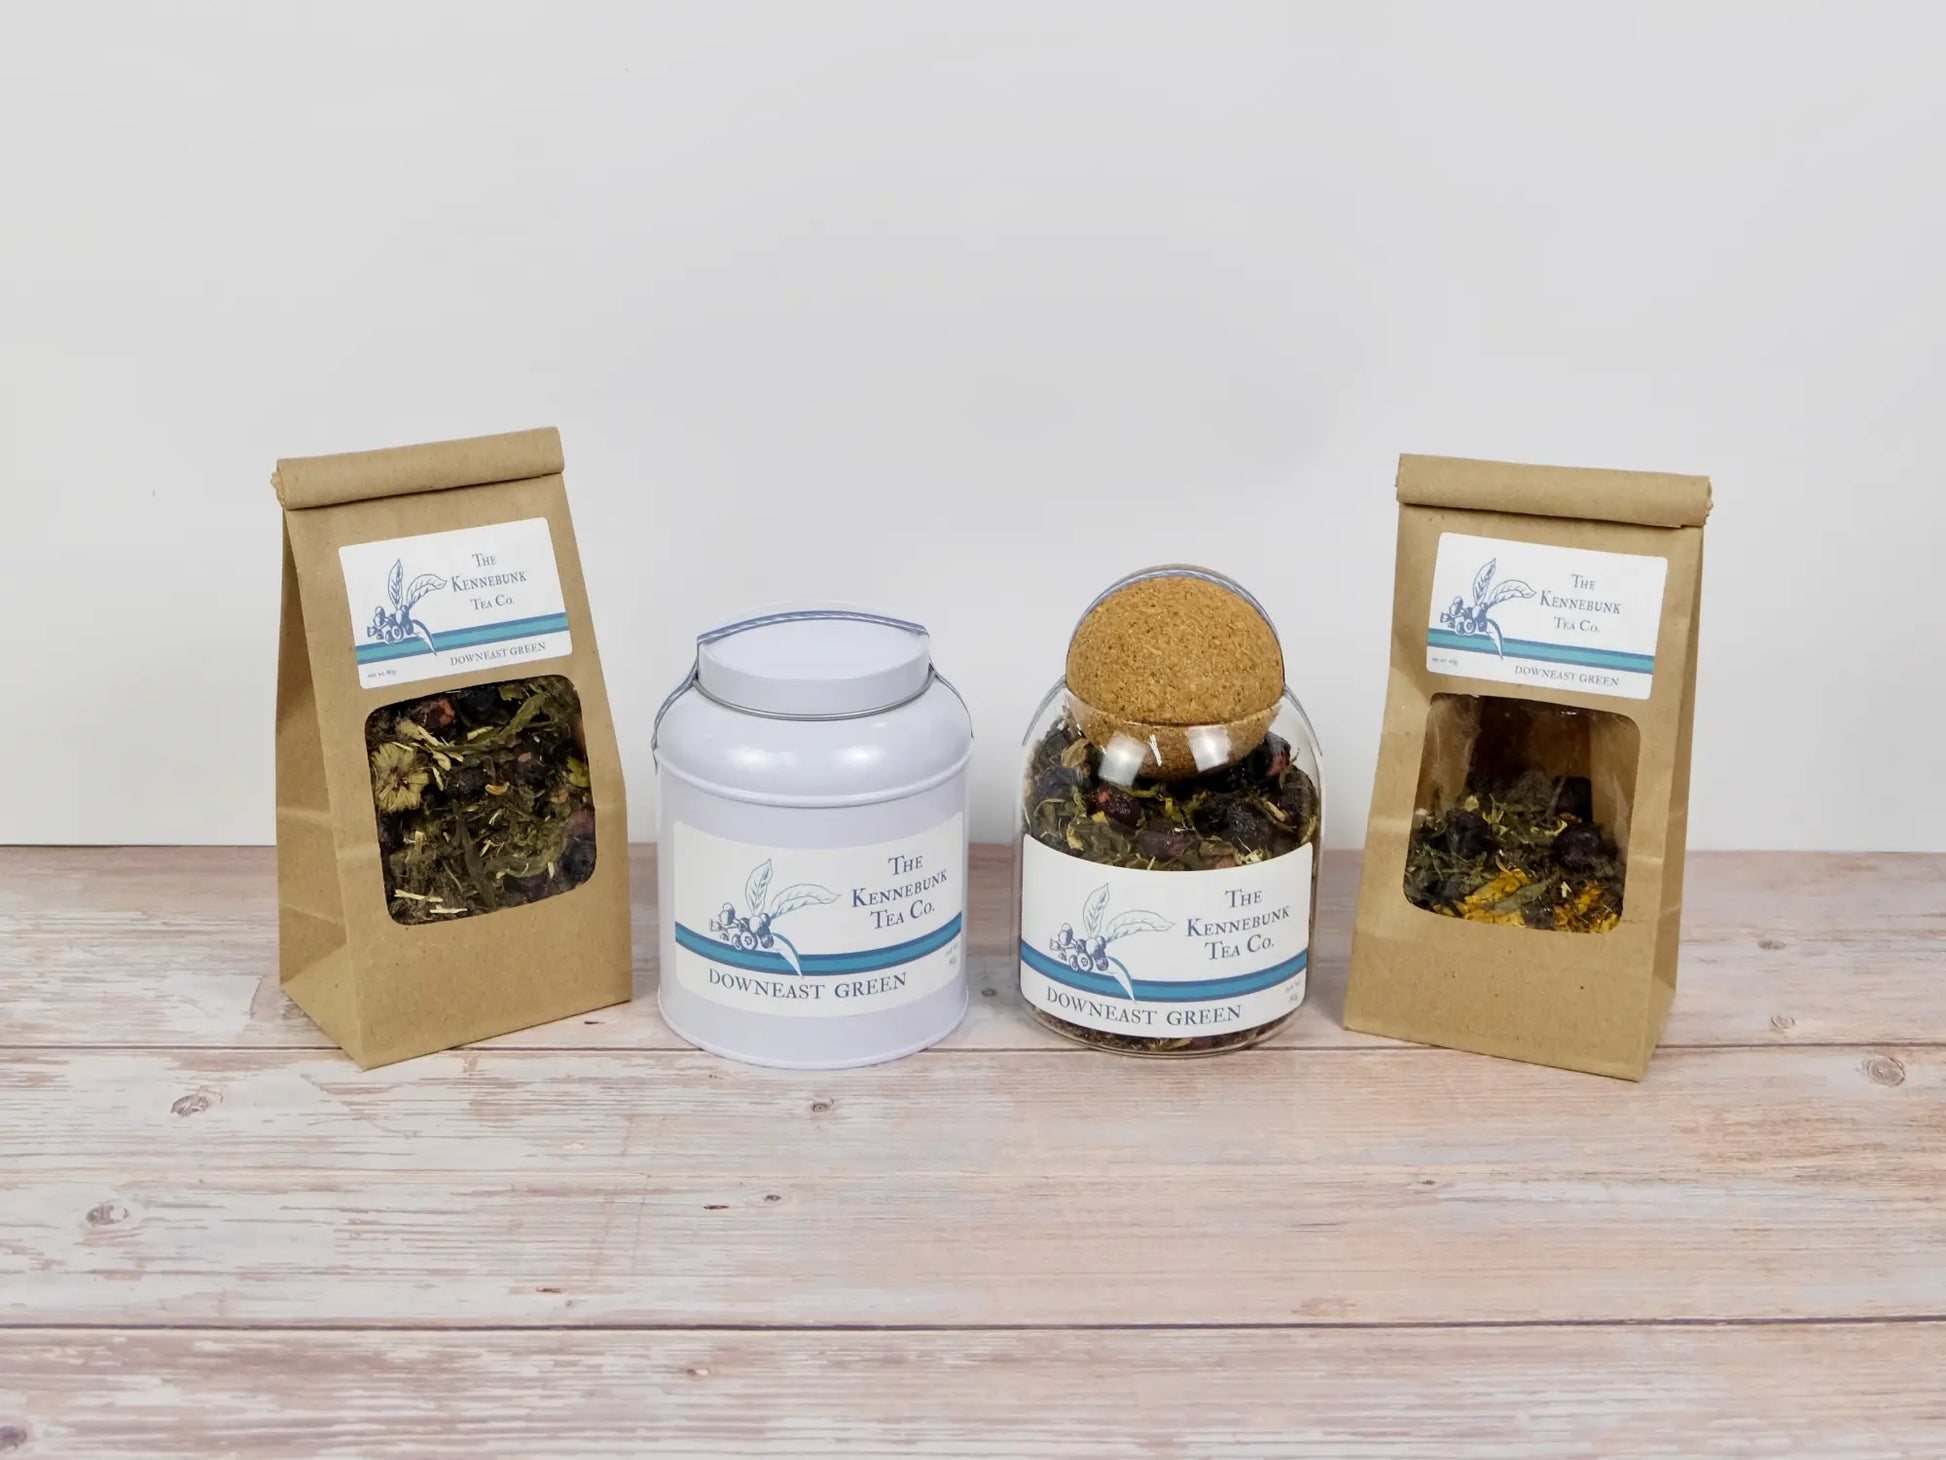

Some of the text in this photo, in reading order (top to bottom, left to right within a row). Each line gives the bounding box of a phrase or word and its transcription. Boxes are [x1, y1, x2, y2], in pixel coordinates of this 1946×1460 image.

[471, 553, 497, 568] THE
[451, 571, 527, 593] KENNEBUNK
[1571, 573, 1596, 590] THE
[470, 598, 493, 611] TEA
[1539, 590, 1622, 615] KENNEBUNK
[1553, 616, 1577, 630] TEA
[450, 642, 546, 666] DOWNEAST GREEN
[1514, 665, 1620, 687] DOWNEAST GREEN
[888, 855, 924, 876] THE
[851, 869, 948, 908] KENNEBUNK
[1225, 888, 1263, 908] THE
[870, 899, 935, 930] TEA CO.
[1186, 906, 1290, 938] KENNEBUNK
[1204, 934, 1275, 960] TEA CO.
[709, 968, 907, 1000] DOWNEAST GREEN
[1046, 986, 1243, 1026] DOWNEAST GREEN
